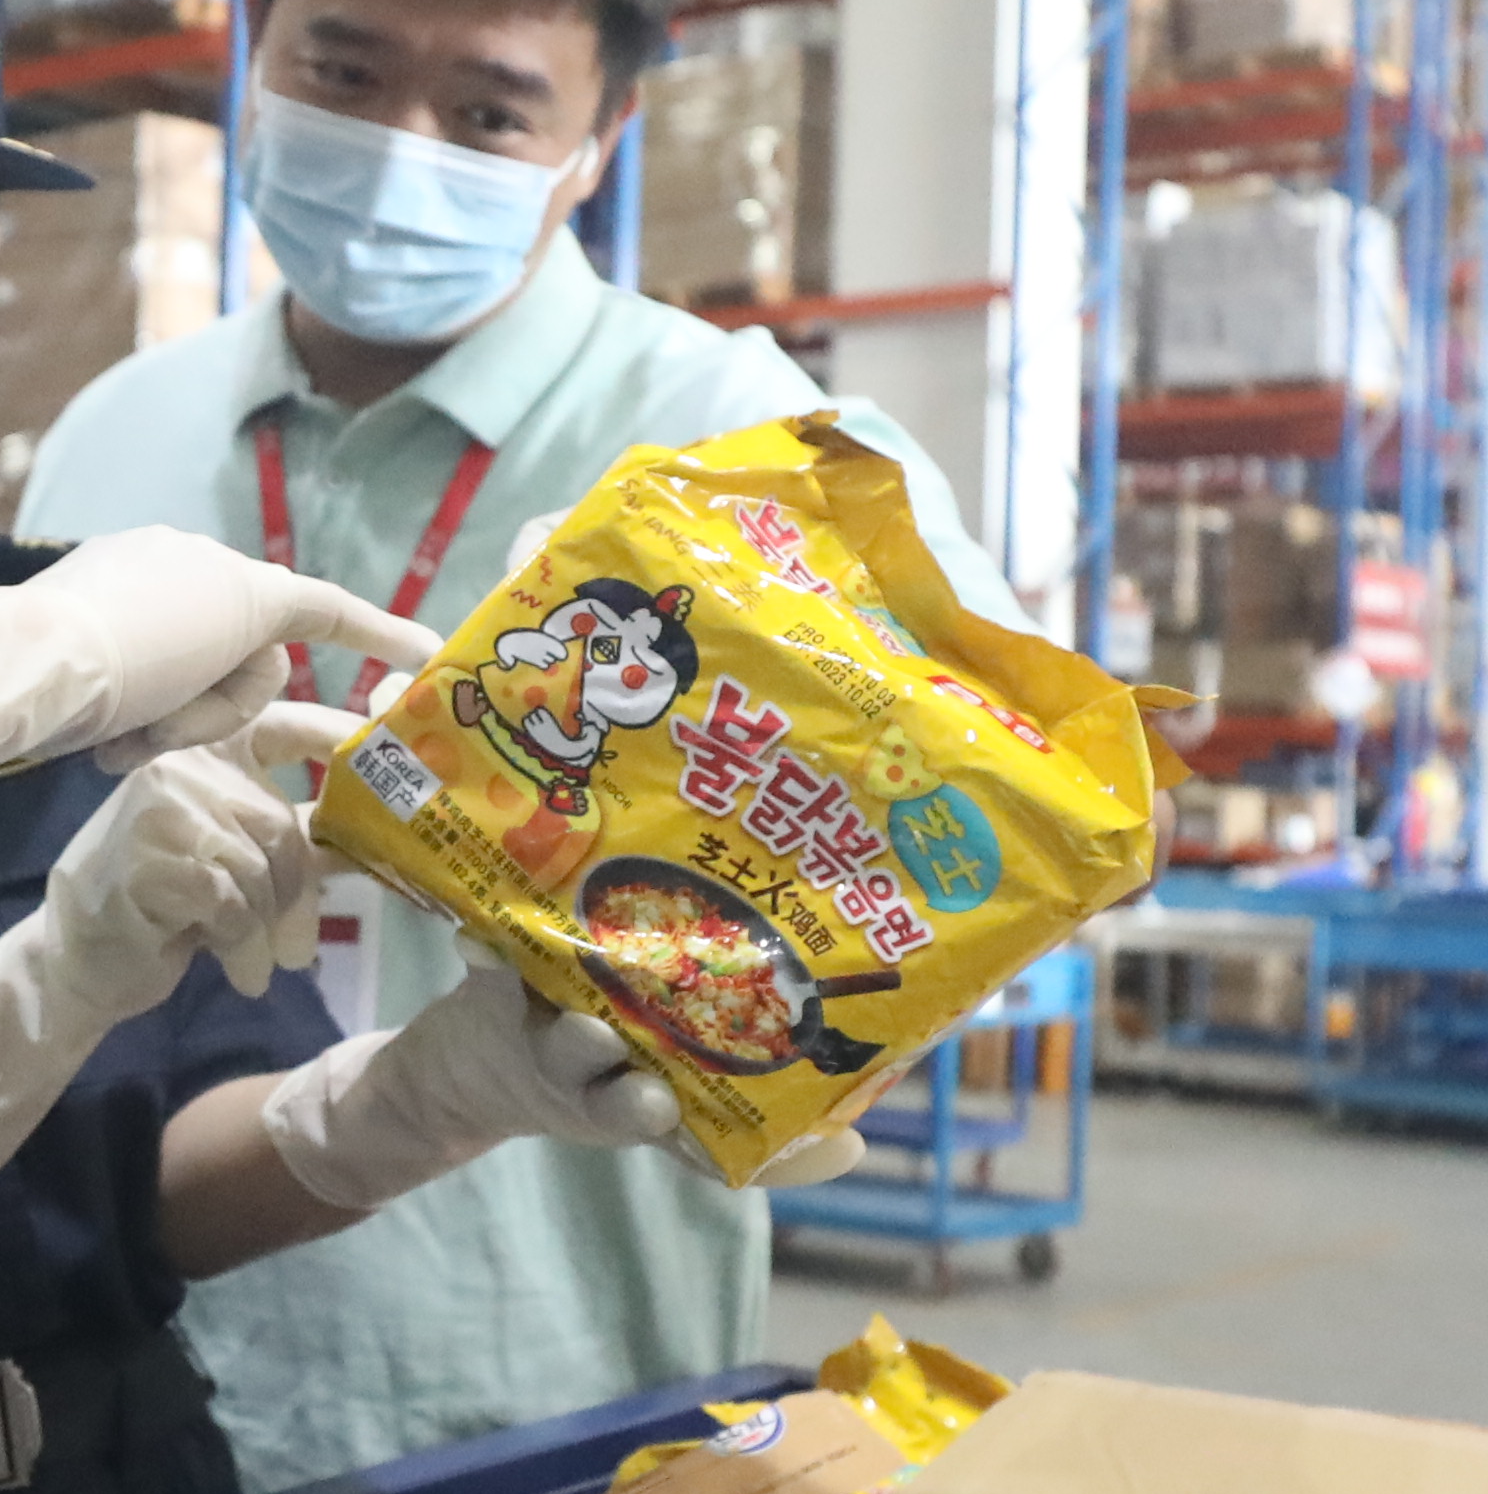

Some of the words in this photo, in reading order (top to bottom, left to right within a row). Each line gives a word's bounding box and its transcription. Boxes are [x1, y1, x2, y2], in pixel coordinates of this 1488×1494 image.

[812, 653, 882, 720] 2023.10.02
[354, 749, 418, 808] 韩国产
[377, 739, 425, 793] KOREA
[672, 675, 932, 961] 불닭볶음면
[902, 797, 982, 897] 芝士
[688, 832, 838, 957] 芝士火鸡面
